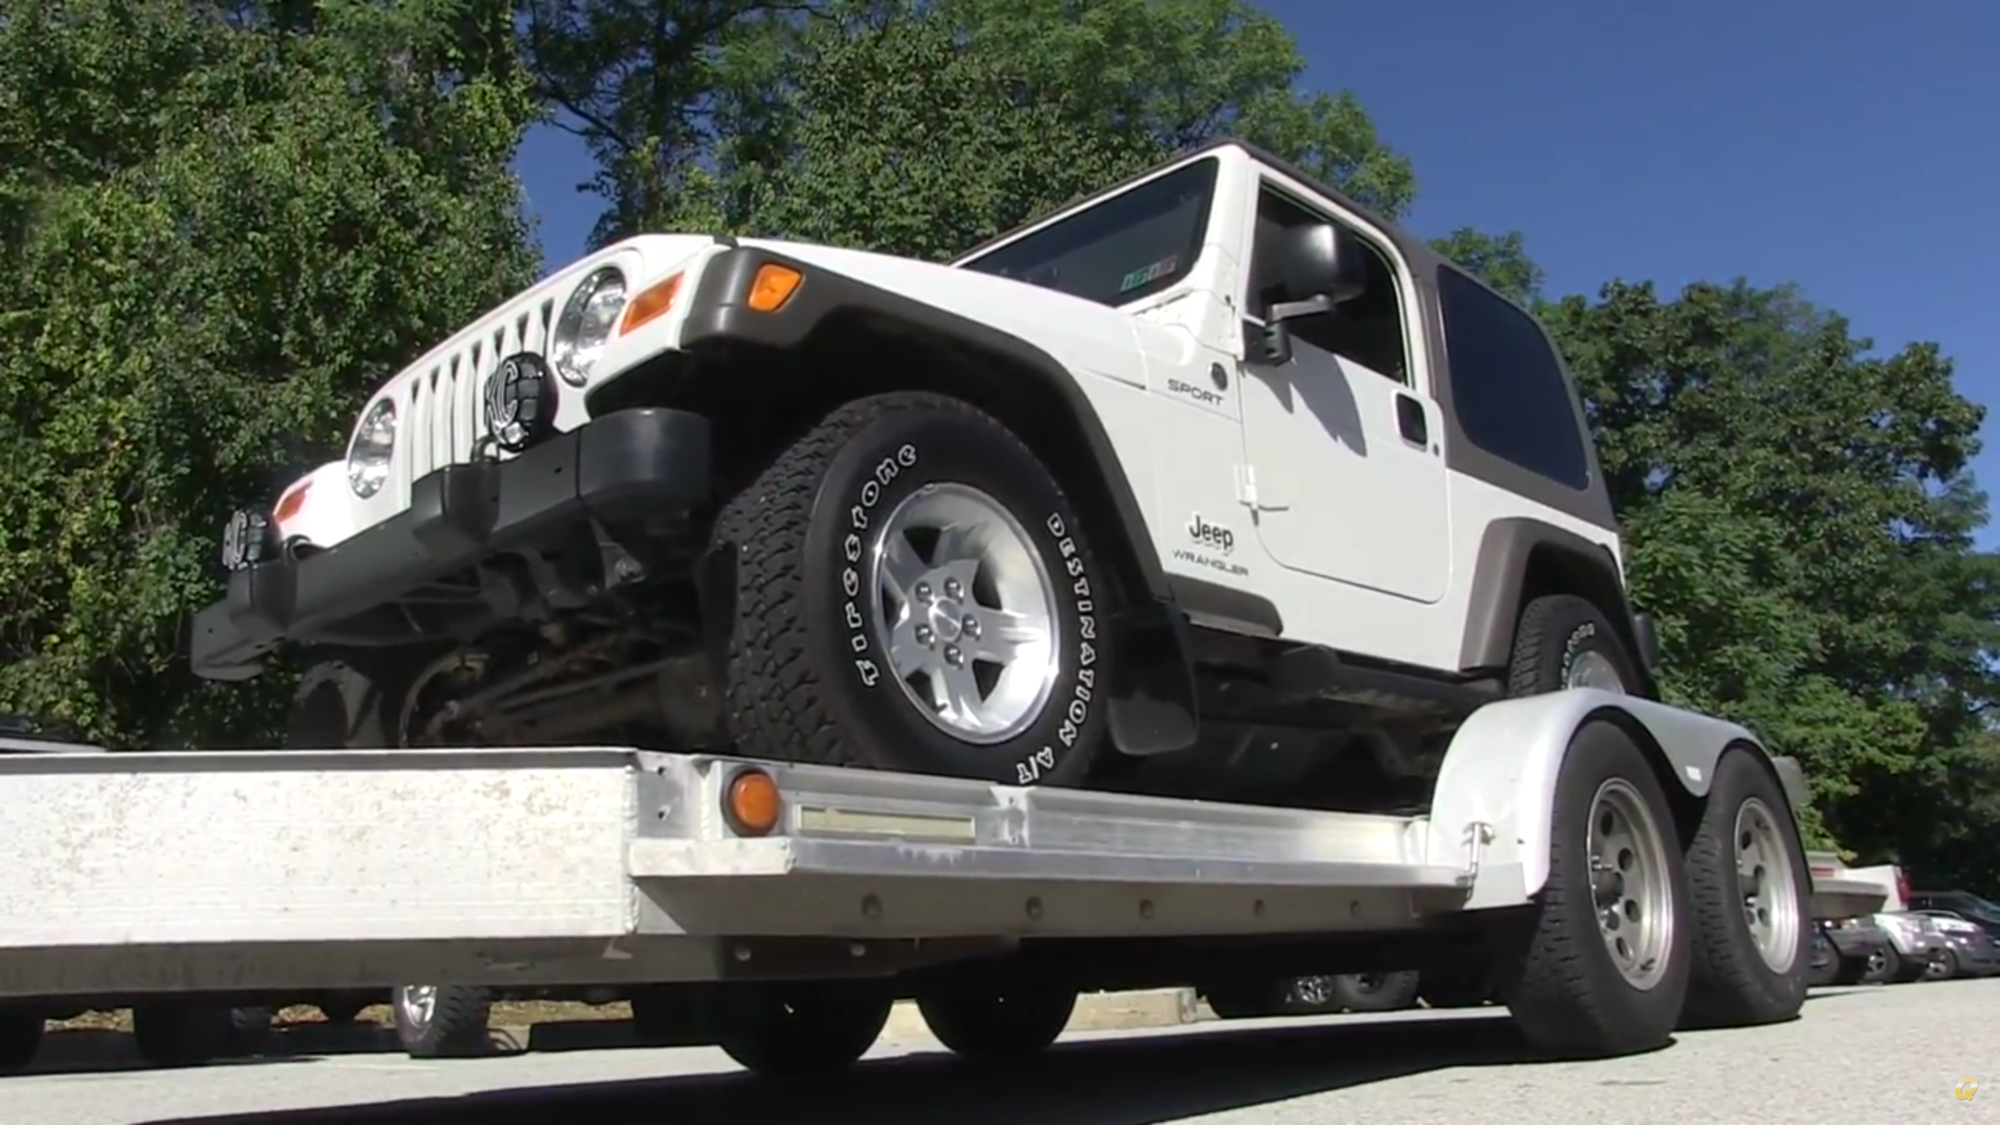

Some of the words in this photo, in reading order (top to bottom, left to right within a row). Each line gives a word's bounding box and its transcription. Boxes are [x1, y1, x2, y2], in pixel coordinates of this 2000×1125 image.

[1167, 378, 1225, 407] SPORT
[1188, 514, 1234, 551] Jeep
[1171, 548, 1250, 577] WRANGLER
[1046, 512, 1098, 747] DESTINATION
[1015, 745, 1056, 785] A/T
